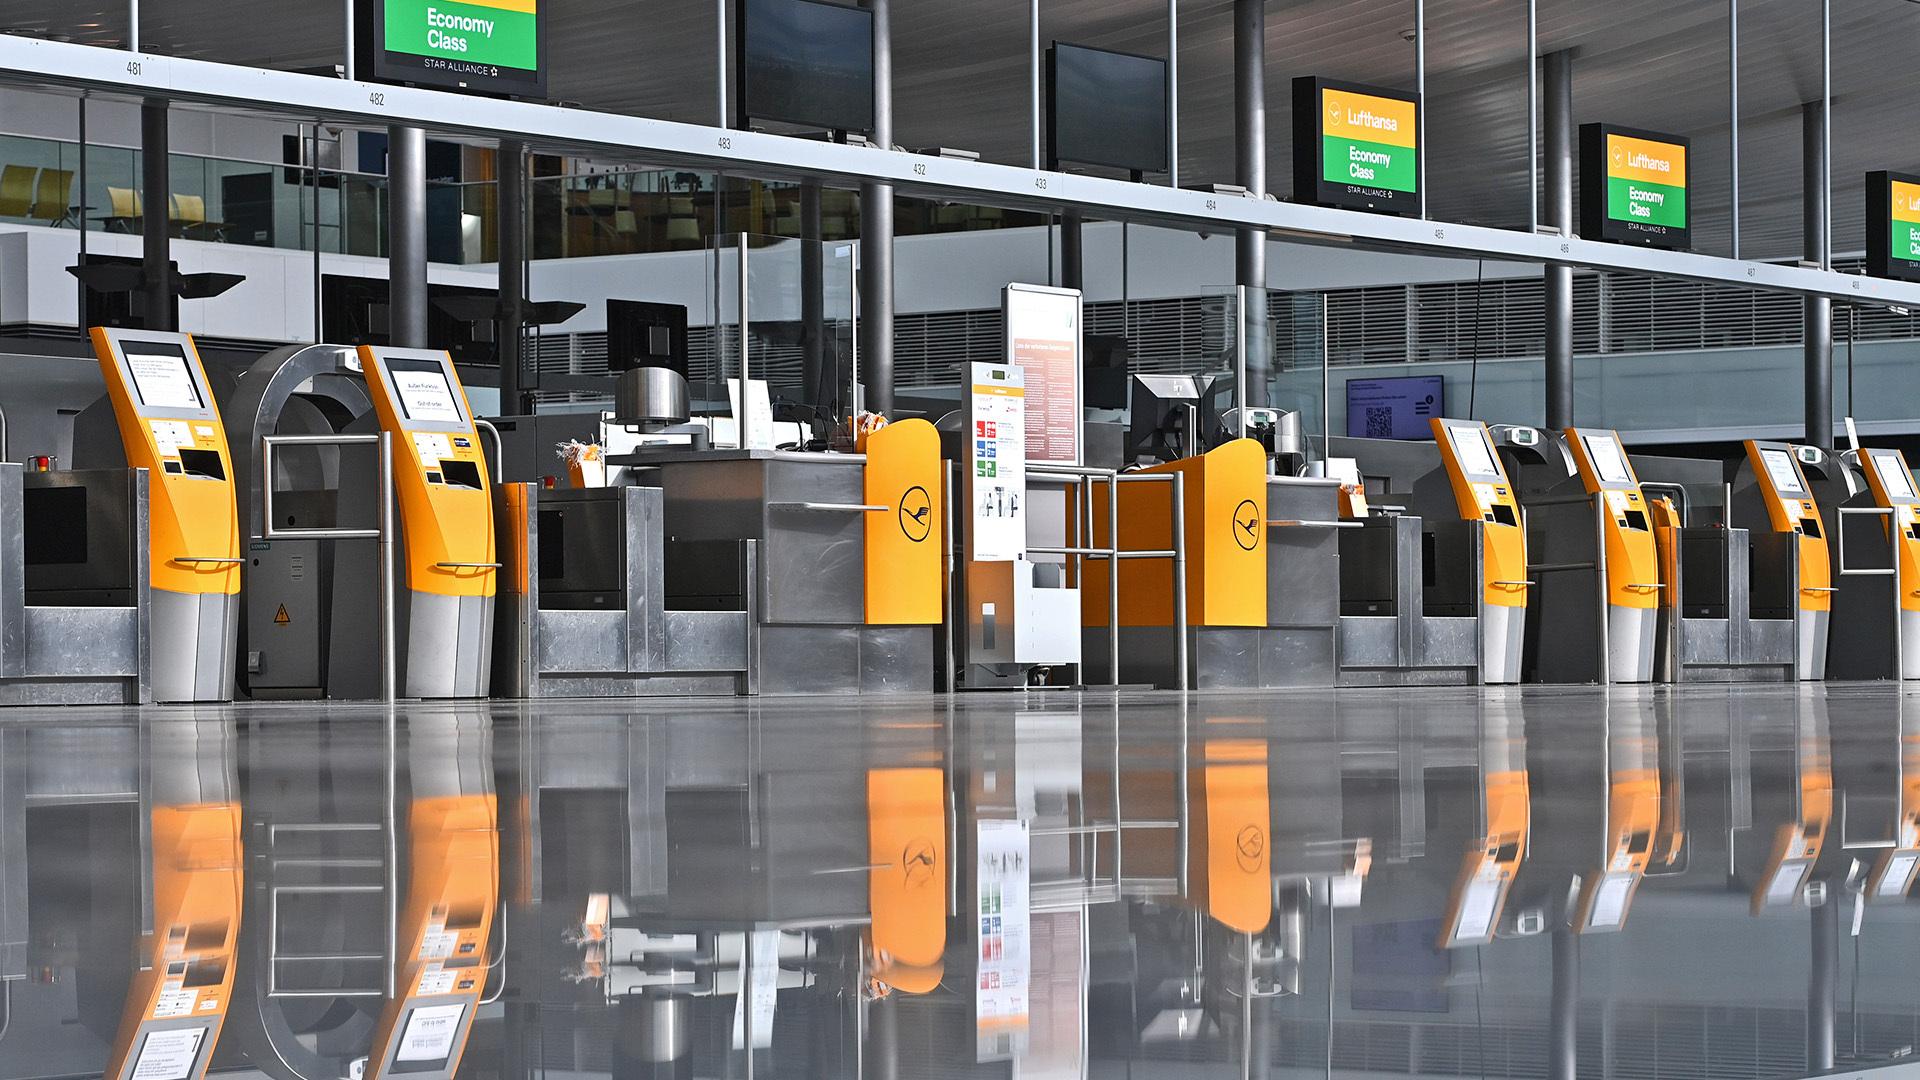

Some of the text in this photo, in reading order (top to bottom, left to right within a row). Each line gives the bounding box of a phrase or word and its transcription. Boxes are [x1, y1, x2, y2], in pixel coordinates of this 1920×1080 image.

[427, 7, 494, 38] Economy
[427, 30, 467, 52] Class
[127, 61, 142, 76] 481
[424, 58, 489, 75] STAR ALLIANCE
[369, 92, 384, 106] 482
[1347, 107, 1398, 131] Lufthansa
[717, 137, 731, 150] 483
[1349, 145, 1391, 168] Economy
[1627, 151, 1670, 173] Lufthansa
[912, 163, 926, 176] 432
[1349, 163, 1375, 180] Class
[1035, 178, 1048, 191] 433
[1347, 185, 1387, 198] STAR ALLIANCE
[1629, 185, 1665, 206] Economy
[1205, 199, 1217, 211] 484
[1629, 201, 1651, 217] Class
[1434, 228, 1445, 239] 485
[1627, 222, 1639, 230] STAR
